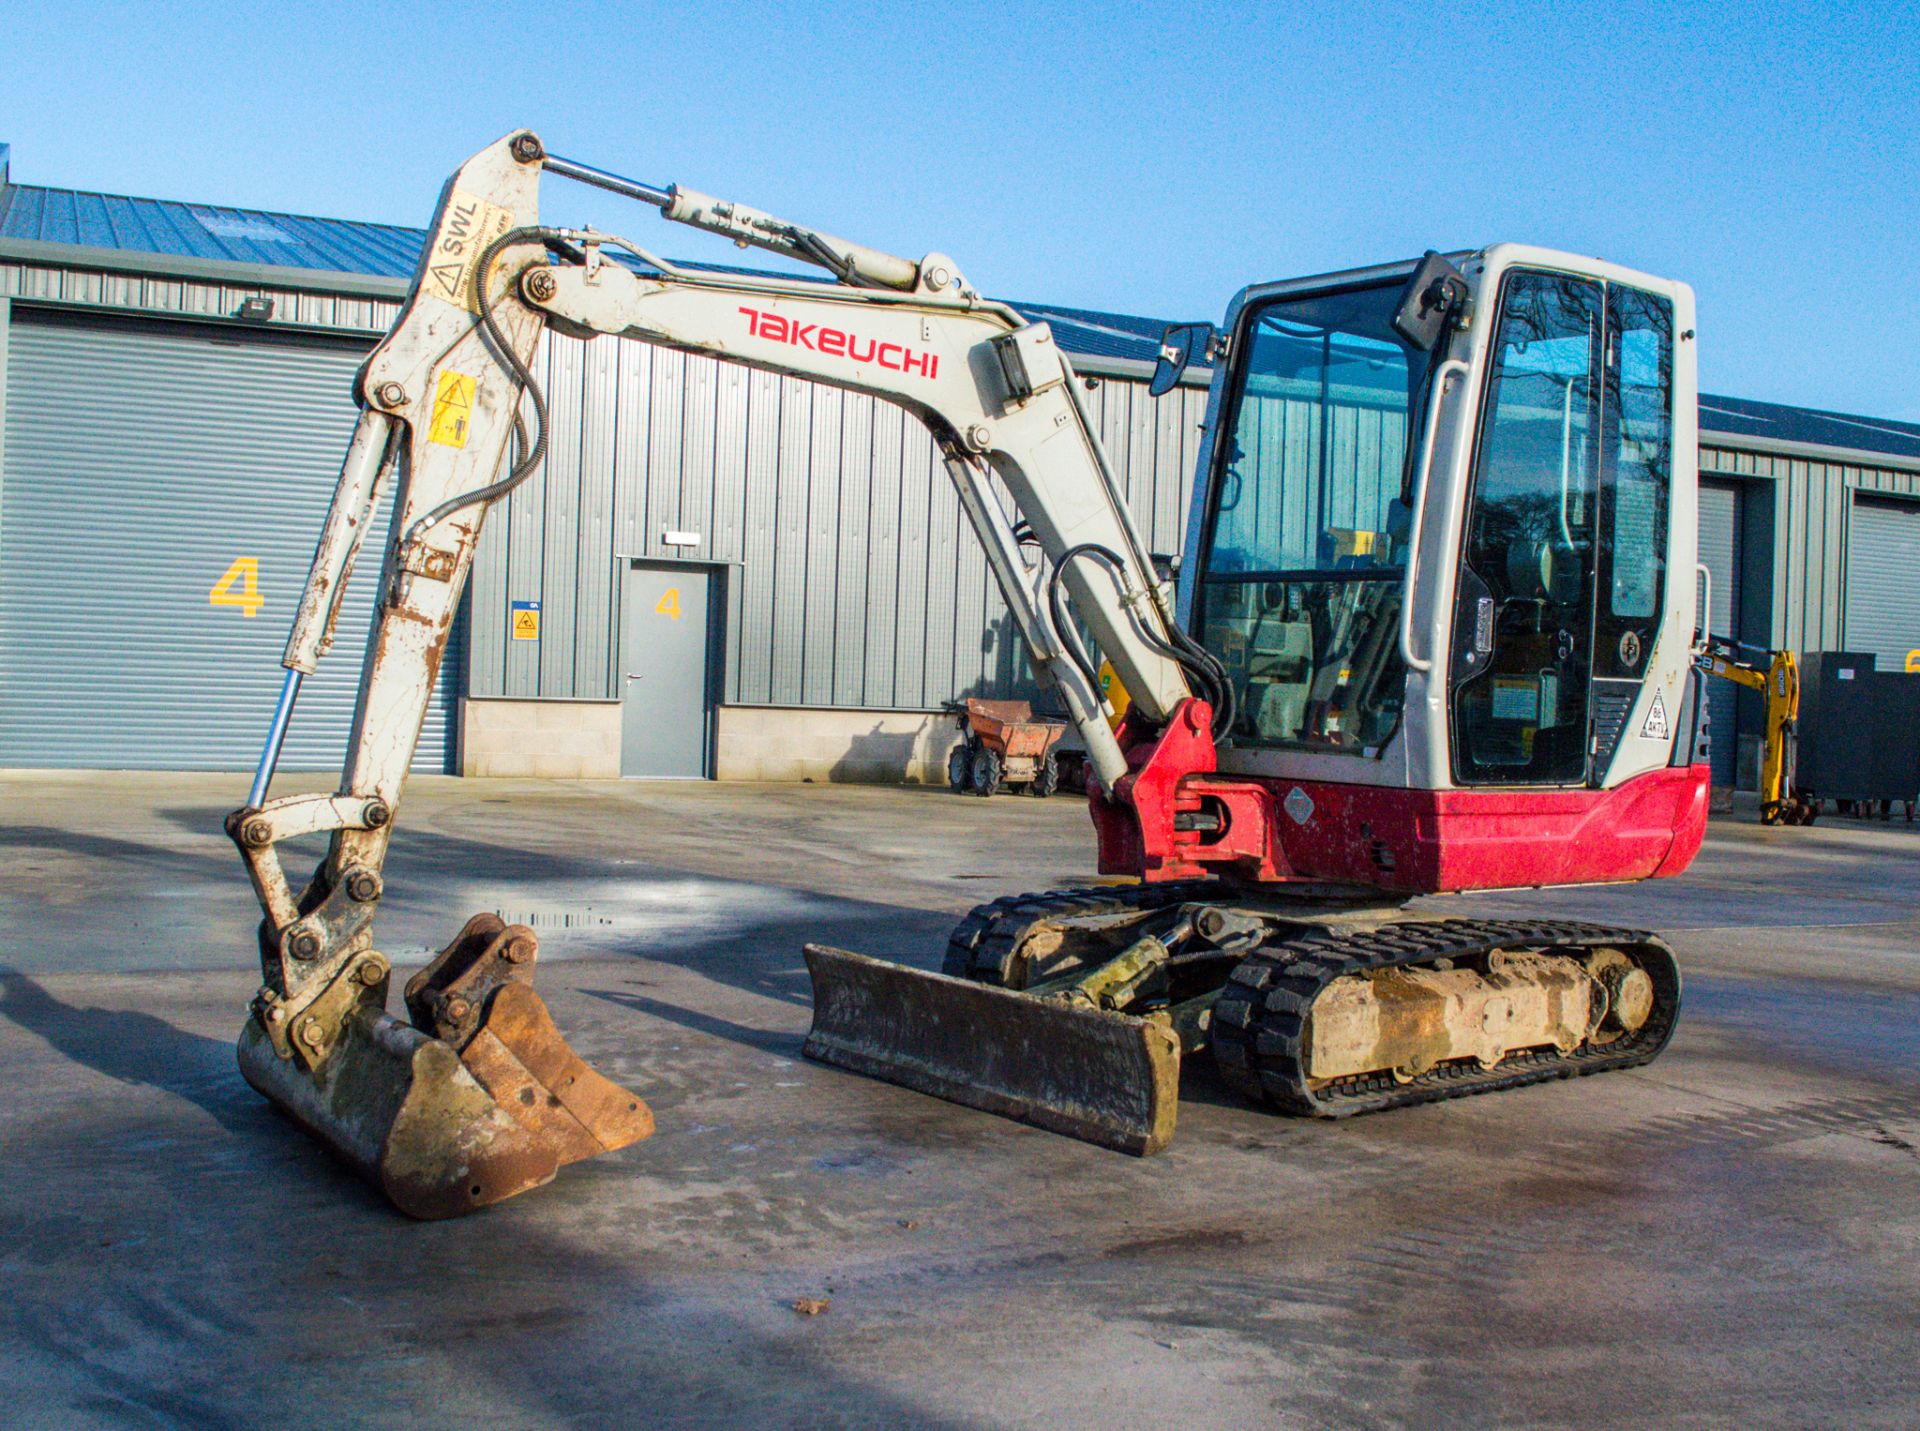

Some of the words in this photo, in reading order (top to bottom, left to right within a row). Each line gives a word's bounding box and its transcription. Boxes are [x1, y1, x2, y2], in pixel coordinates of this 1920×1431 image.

[443, 203, 477, 256] SWL
[209, 556, 264, 618] 4
[656, 588, 682, 620] 4
